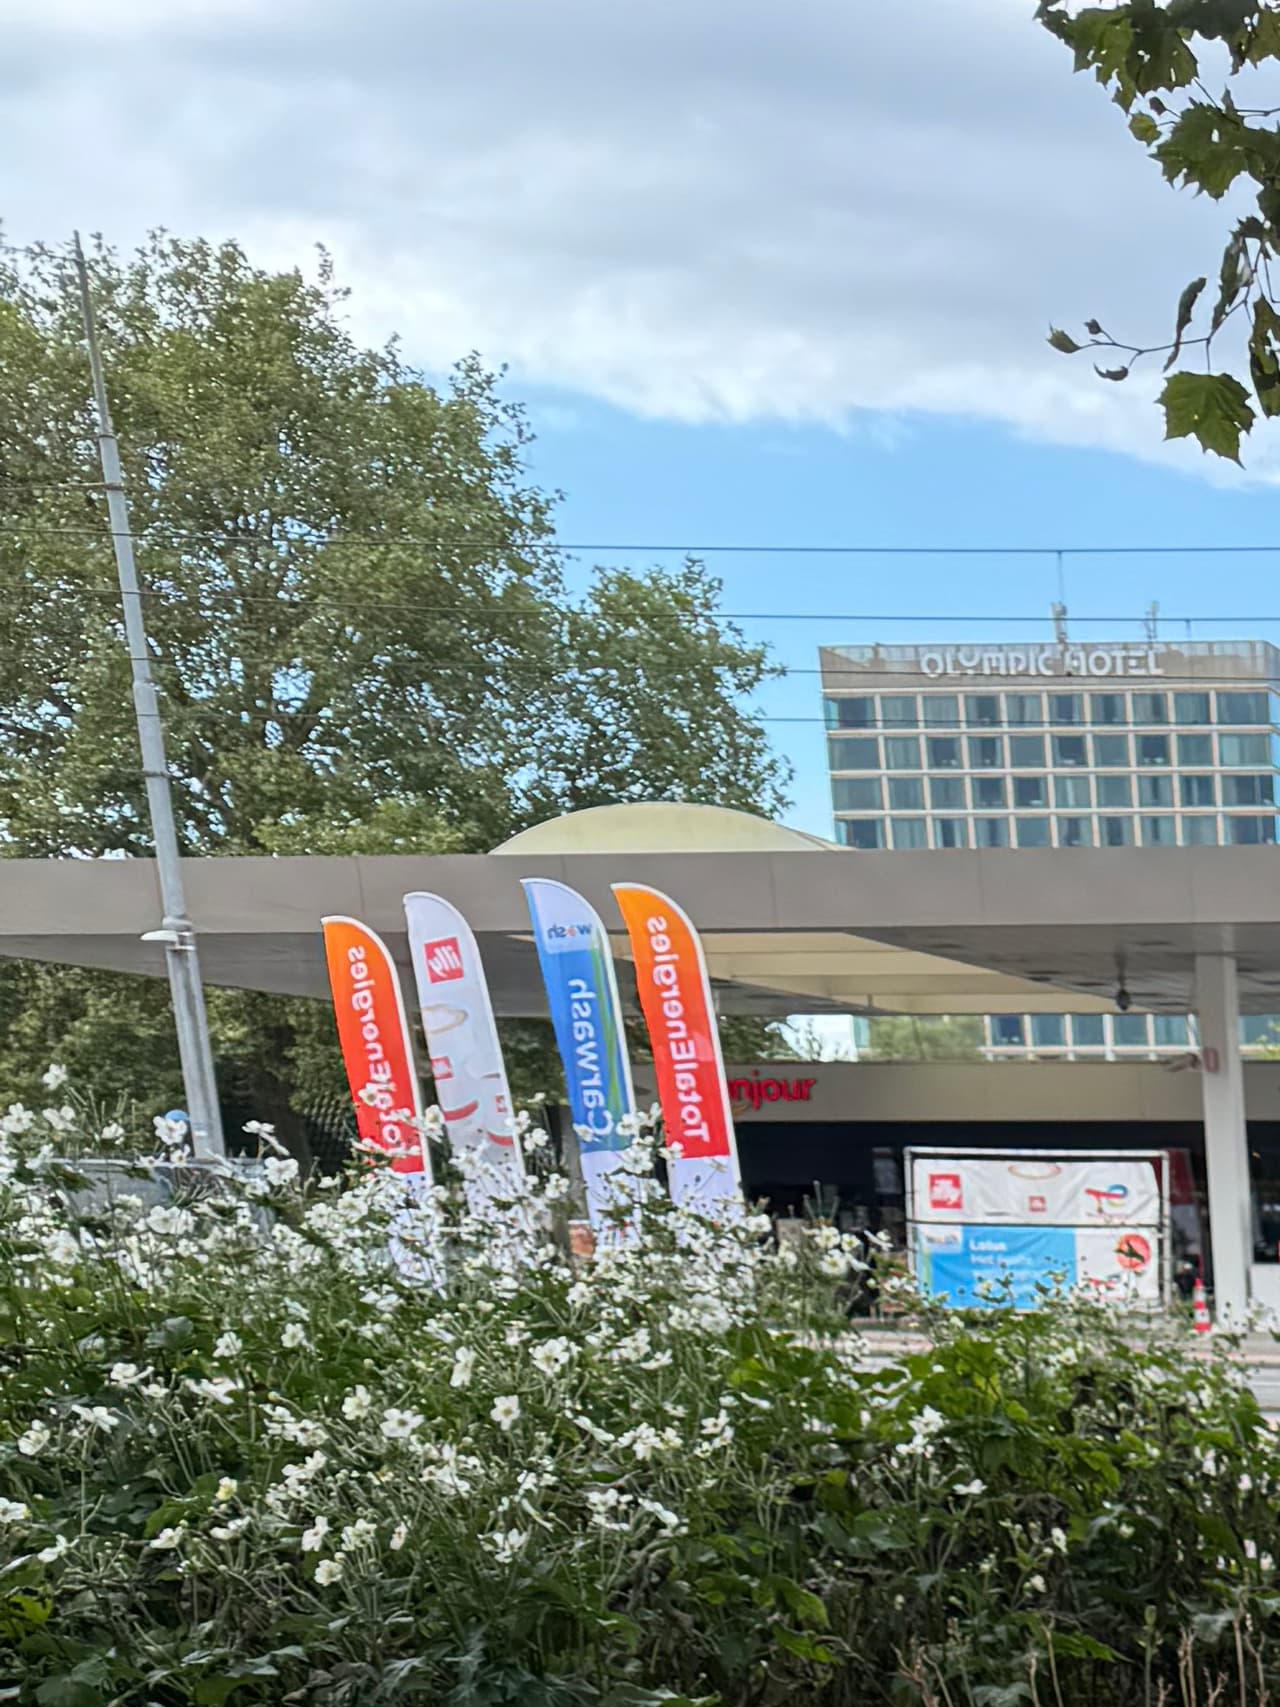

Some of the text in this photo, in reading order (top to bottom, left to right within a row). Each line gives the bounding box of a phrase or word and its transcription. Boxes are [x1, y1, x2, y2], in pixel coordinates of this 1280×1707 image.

[920, 649, 1165, 677] OLYMPIC HOTEL
[727, 1068, 816, 1111] njour
